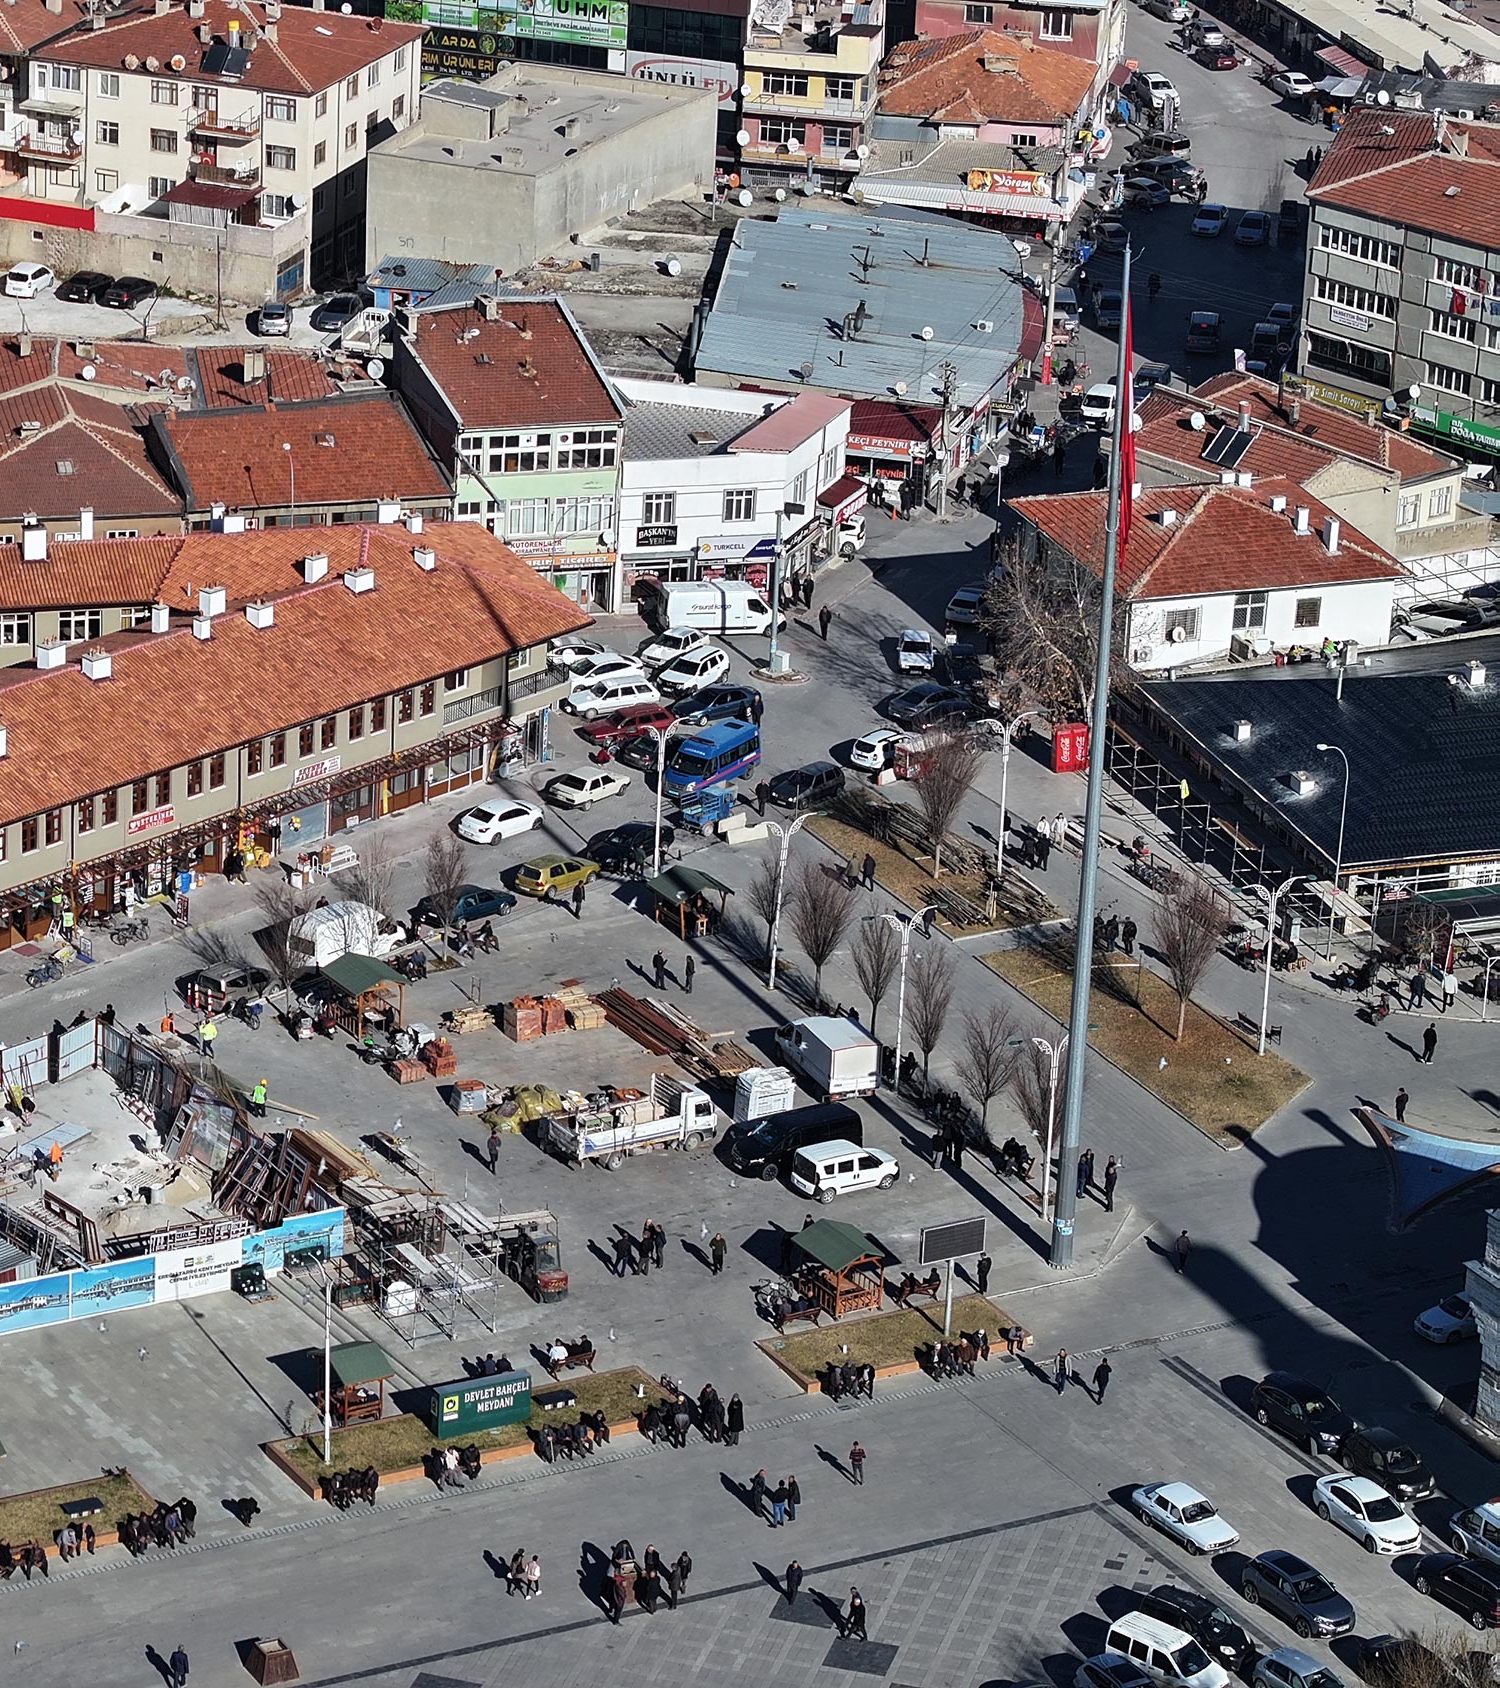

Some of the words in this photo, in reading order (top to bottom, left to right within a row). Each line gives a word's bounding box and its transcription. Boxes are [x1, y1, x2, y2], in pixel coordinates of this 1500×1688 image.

[1321, 388, 1339, 401] Simit
[1340, 394, 1361, 409] Sarayı
[848, 435, 870, 446] KEÇİ
[713, 543, 746, 551] TURKCELL
[525, 559, 554, 567] ARIM
[464, 1387, 495, 1403] DEVLET
[495, 1378, 529, 1398] BAHÇELİ
[477, 1396, 514, 1413] MEYDANI
